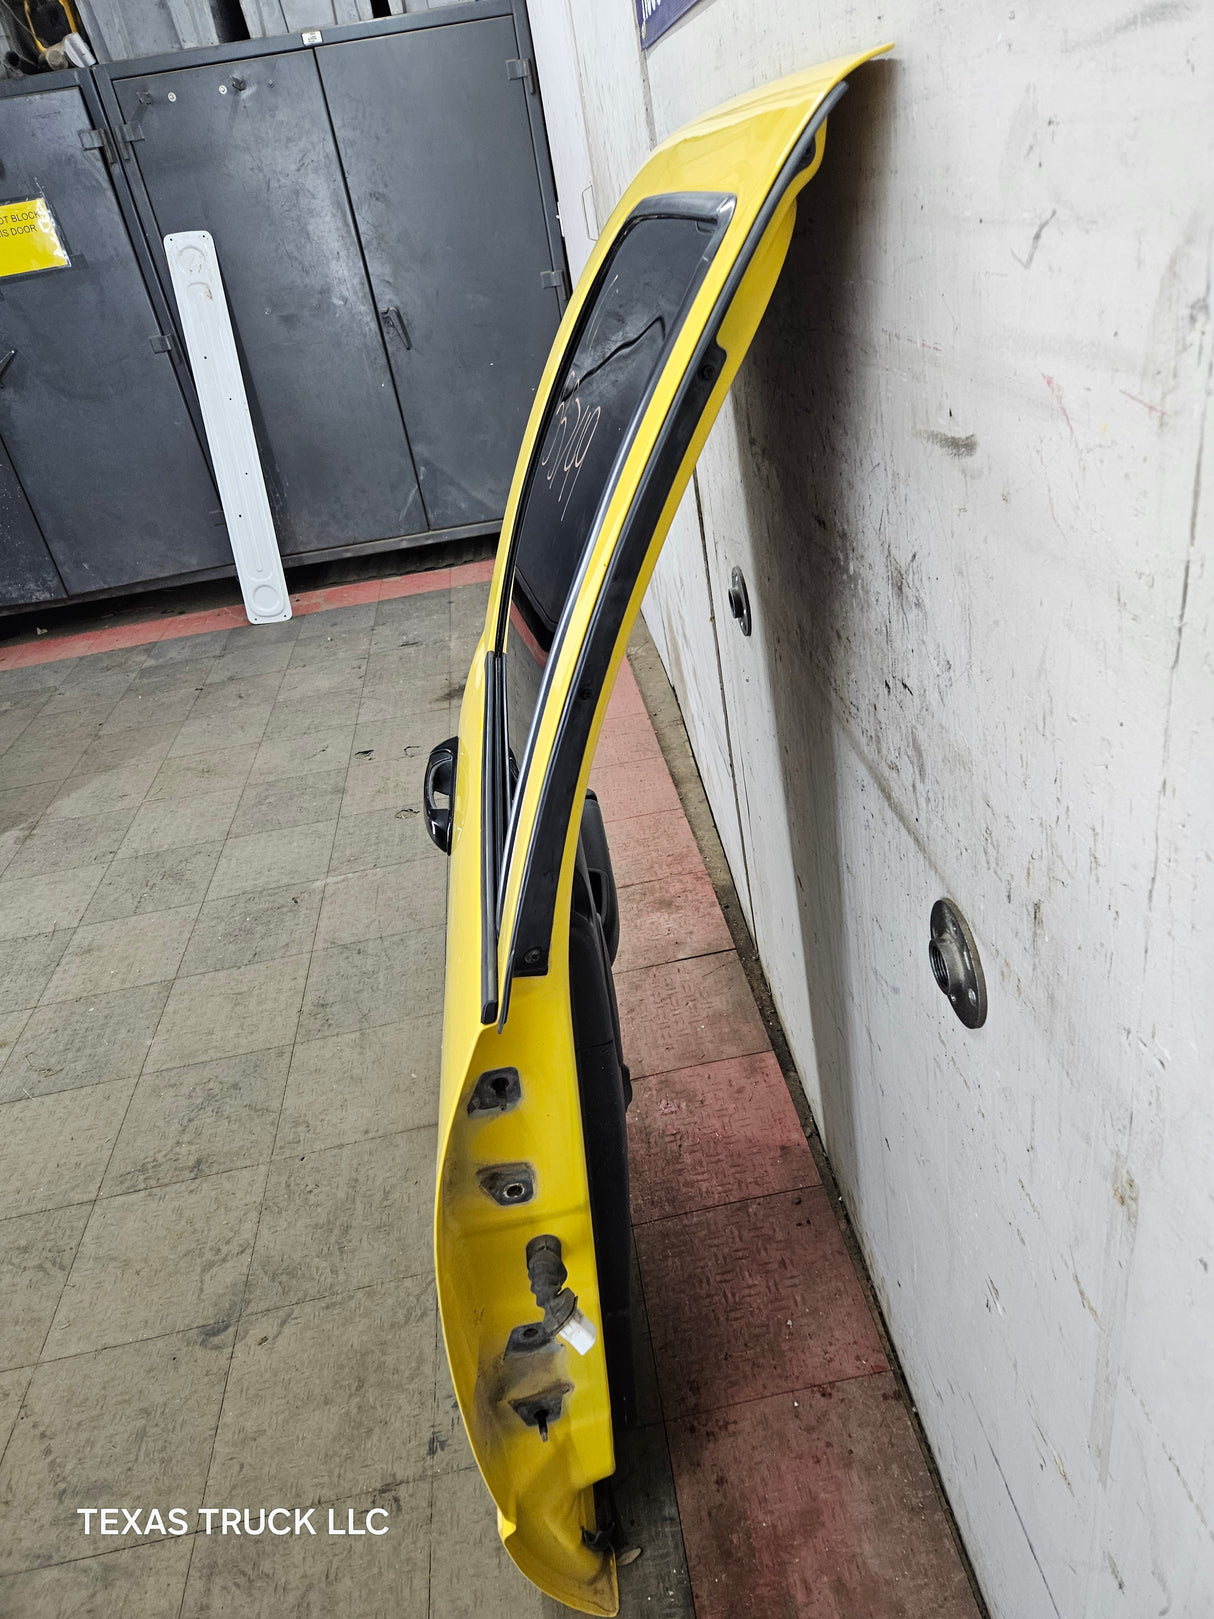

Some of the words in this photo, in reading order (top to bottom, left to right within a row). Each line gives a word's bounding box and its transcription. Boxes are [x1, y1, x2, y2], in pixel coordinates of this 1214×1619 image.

[11, 211, 40, 222] BLOCK
[0, 229, 9, 237] IS
[10, 224, 37, 235] DOOR
